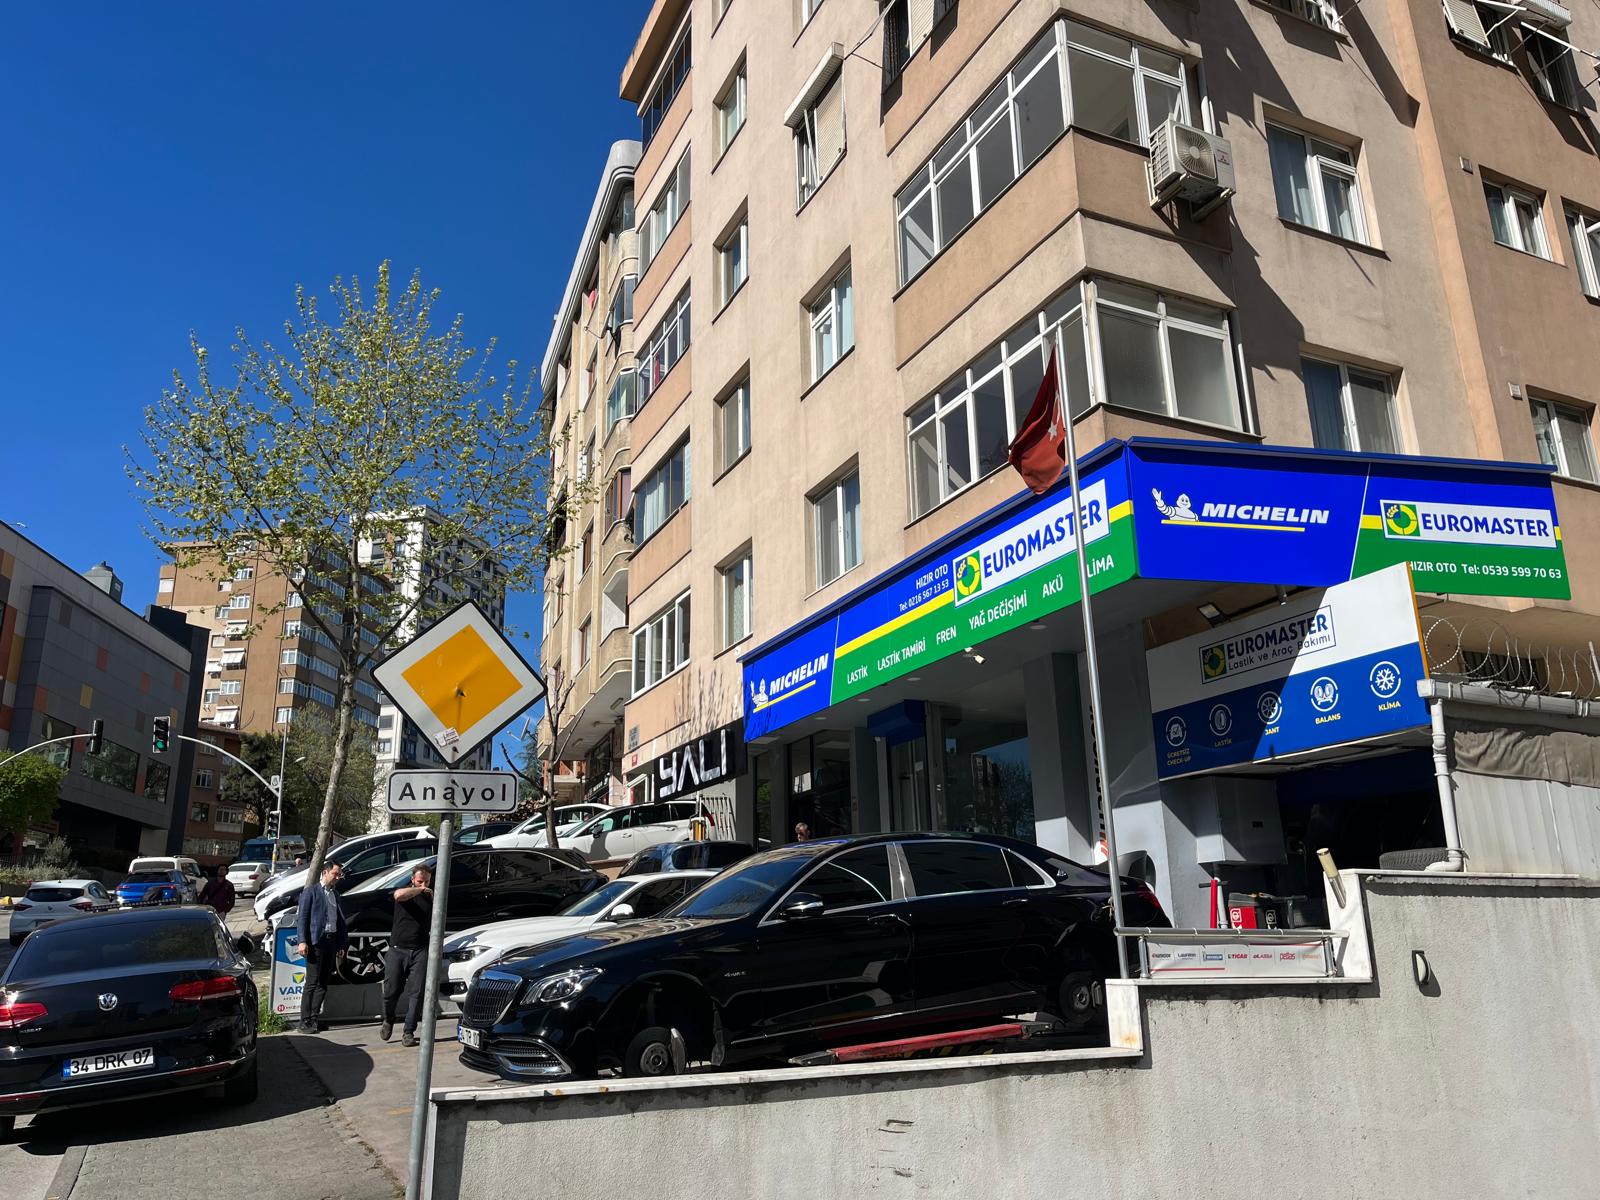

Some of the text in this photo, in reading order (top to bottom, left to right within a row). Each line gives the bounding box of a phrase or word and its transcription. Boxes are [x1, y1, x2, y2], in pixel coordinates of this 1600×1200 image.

[1201, 503, 1329, 524] MICHELIN
[1421, 513, 1549, 537] EUROMASTER
[983, 499, 1102, 578] EUROMASTER
[916, 564, 948, 589] HIZIR OTO
[1436, 562, 1457, 573] OTO
[1461, 563, 1480, 575] Tel:
[1482, 564, 1509, 576] 0539
[1511, 566, 1531, 577] 599
[1533, 567, 1547, 578] 70
[1549, 568, 1562, 579] 63
[908, 594, 922, 607] 0216
[922, 588, 933, 600] 567
[933, 583, 941, 593] 13
[941, 579, 949, 589] 53
[847, 554, 1115, 684] LASTİK LASTİK TAMİRİ FREN YAĞ DEĞİŞİMİ AKÜ LİMA
[1227, 614, 1328, 659] EUROMASTER
[1229, 634, 1331, 671] Lastik ve Araç Bakımı
[769, 653, 829, 695] MICHELIN
[1315, 713, 1341, 724] BALANS
[1378, 701, 1401, 712] KLİMA
[659, 728, 727, 798] YALI
[398, 782, 506, 805] Anayol
[279, 985, 305, 997] VAR
[71, 1060, 89, 1074] 34
[94, 1053, 128, 1071] DRK
[133, 1049, 151, 1064] 07
